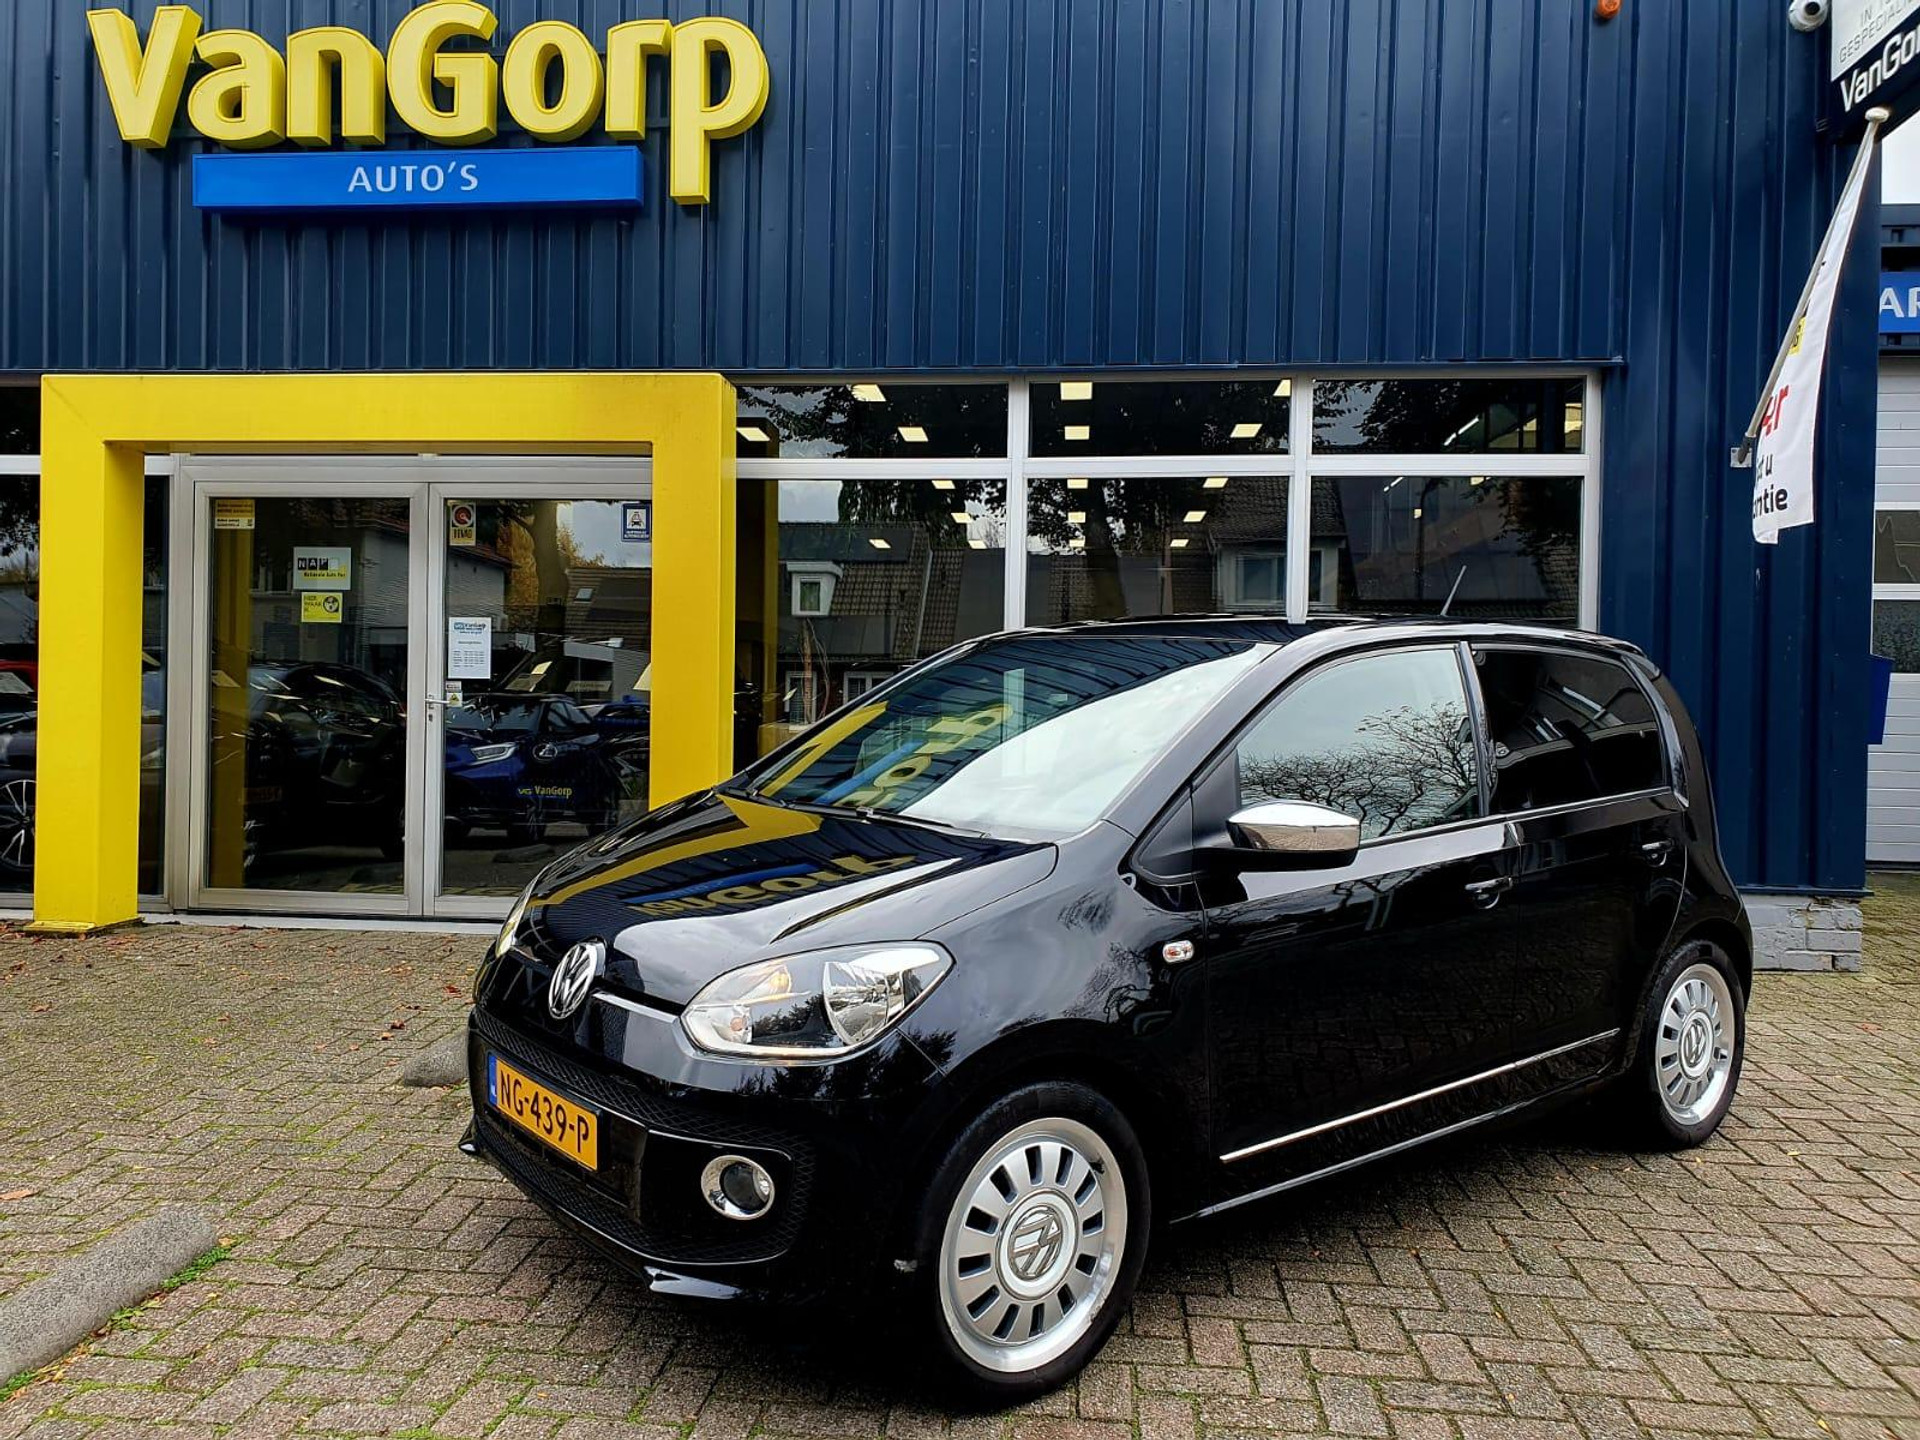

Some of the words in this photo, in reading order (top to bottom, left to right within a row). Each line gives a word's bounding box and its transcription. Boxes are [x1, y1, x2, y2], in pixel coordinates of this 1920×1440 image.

[87, 0, 770, 205] VanGorp
[347, 161, 478, 192] AUTO'S
[534, 785, 572, 799] VanGorp
[501, 1070, 589, 1154] NG-439-P
